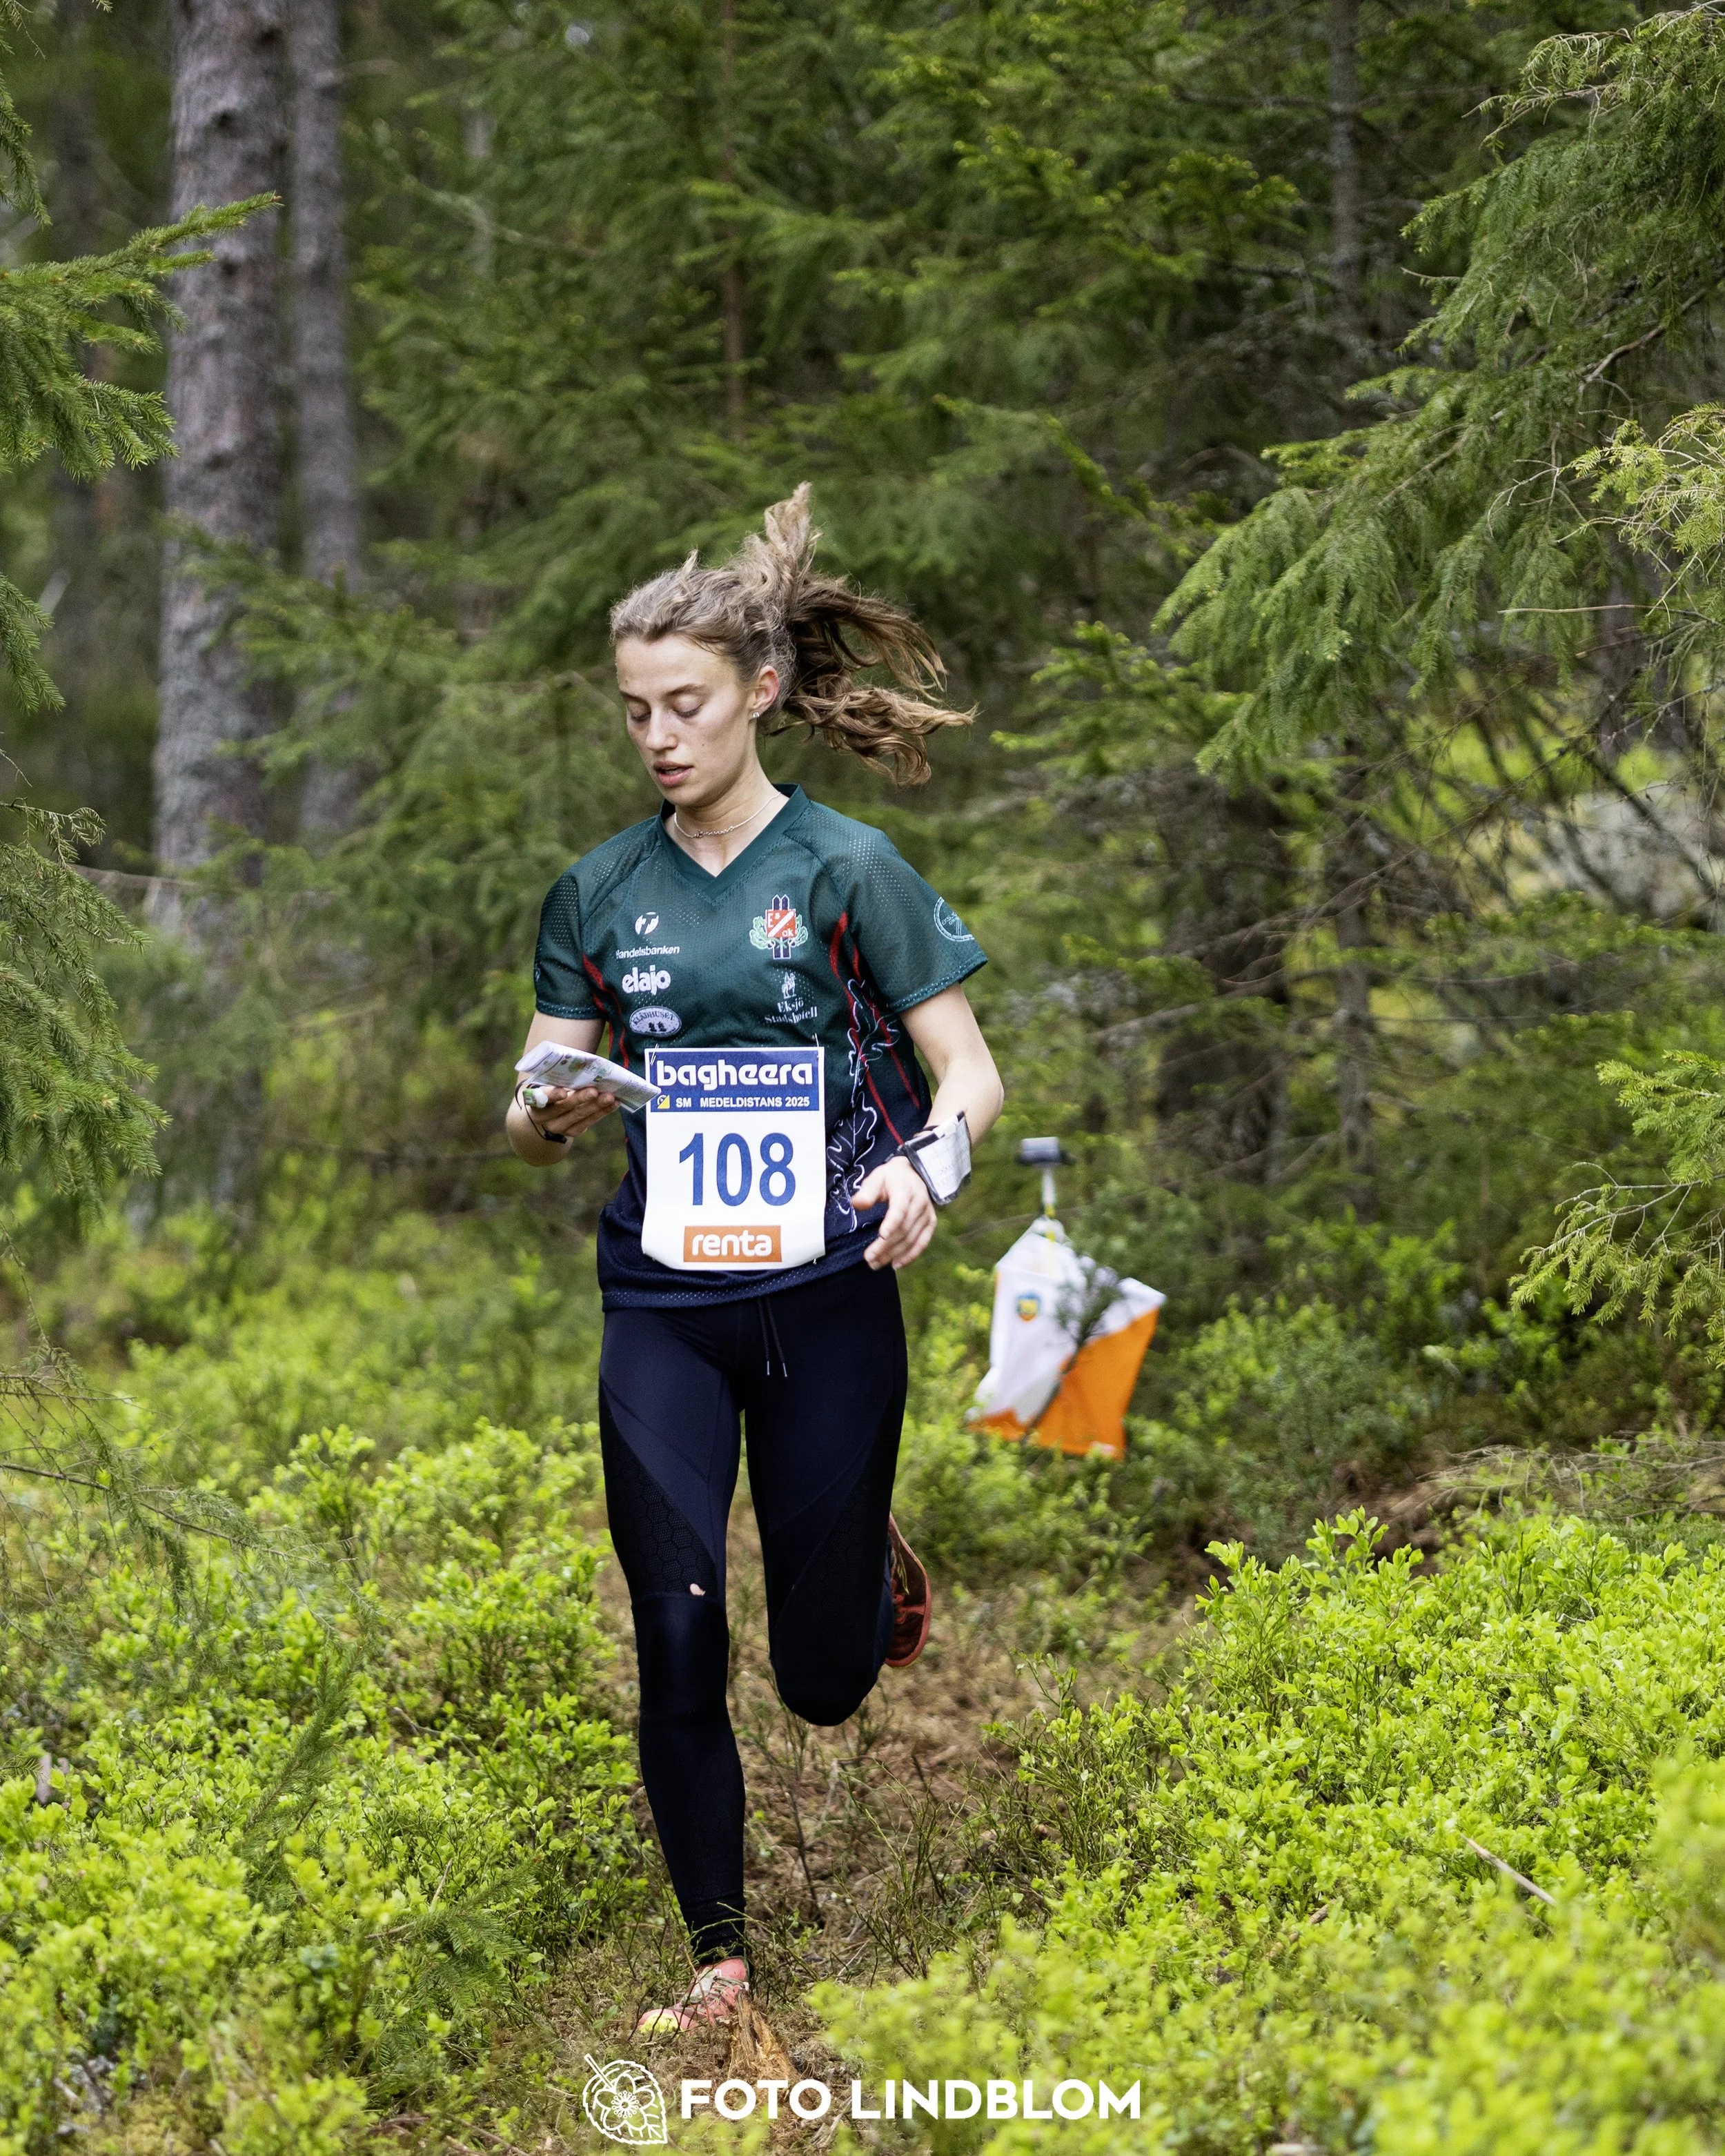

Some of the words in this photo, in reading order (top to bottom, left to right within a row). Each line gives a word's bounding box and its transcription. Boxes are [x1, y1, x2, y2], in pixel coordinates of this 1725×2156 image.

[622, 965, 671, 996] elajo
[656, 1059, 814, 1091] bagheera
[676, 1097, 692, 1108] SM
[700, 1096, 782, 1108] MEDELDISTANS
[785, 1096, 811, 1107] 2025
[679, 1132, 796, 1207] 108
[691, 1229, 772, 1257] renta
